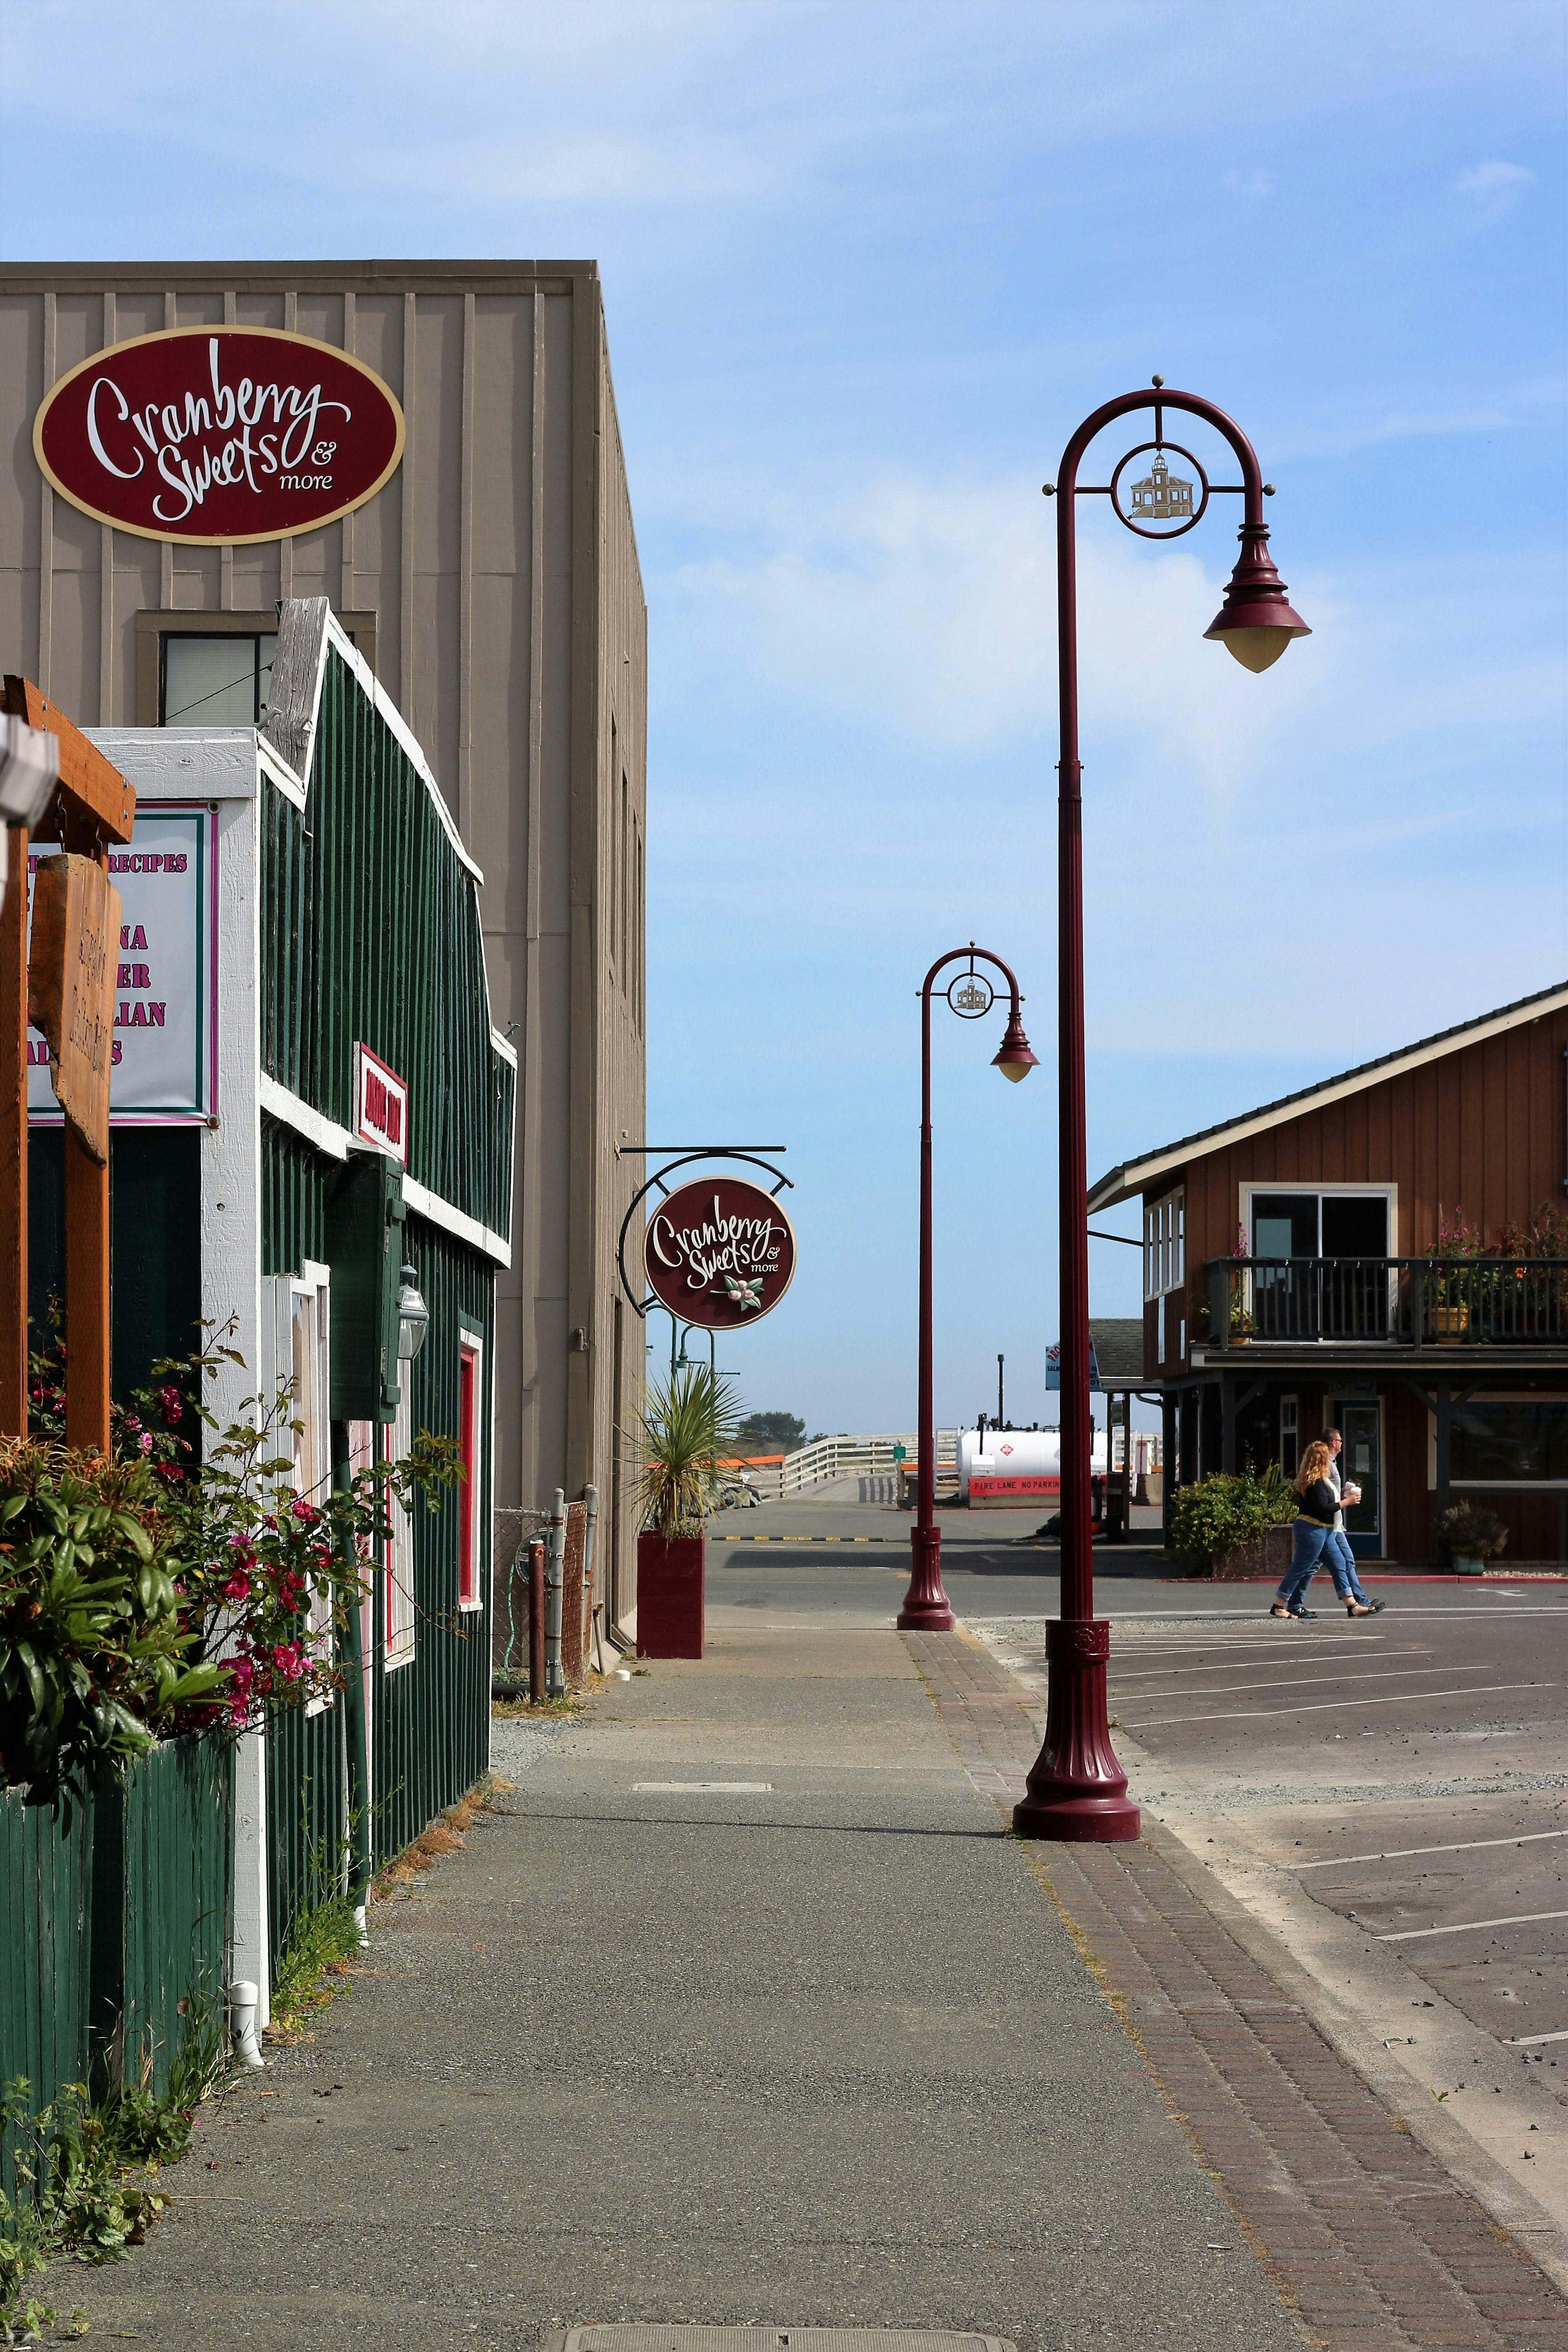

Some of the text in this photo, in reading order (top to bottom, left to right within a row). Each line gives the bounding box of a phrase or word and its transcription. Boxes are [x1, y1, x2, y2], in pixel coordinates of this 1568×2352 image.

[87, 338, 352, 479] Cranberry
[152, 426, 337, 521] Sweets &
[279, 474, 333, 490] more
[107, 854, 187, 873] RECIPES
[653, 1195, 787, 1267] Cranberry
[687, 1240, 781, 1289] Sweets &
[751, 1263, 779, 1272] more
